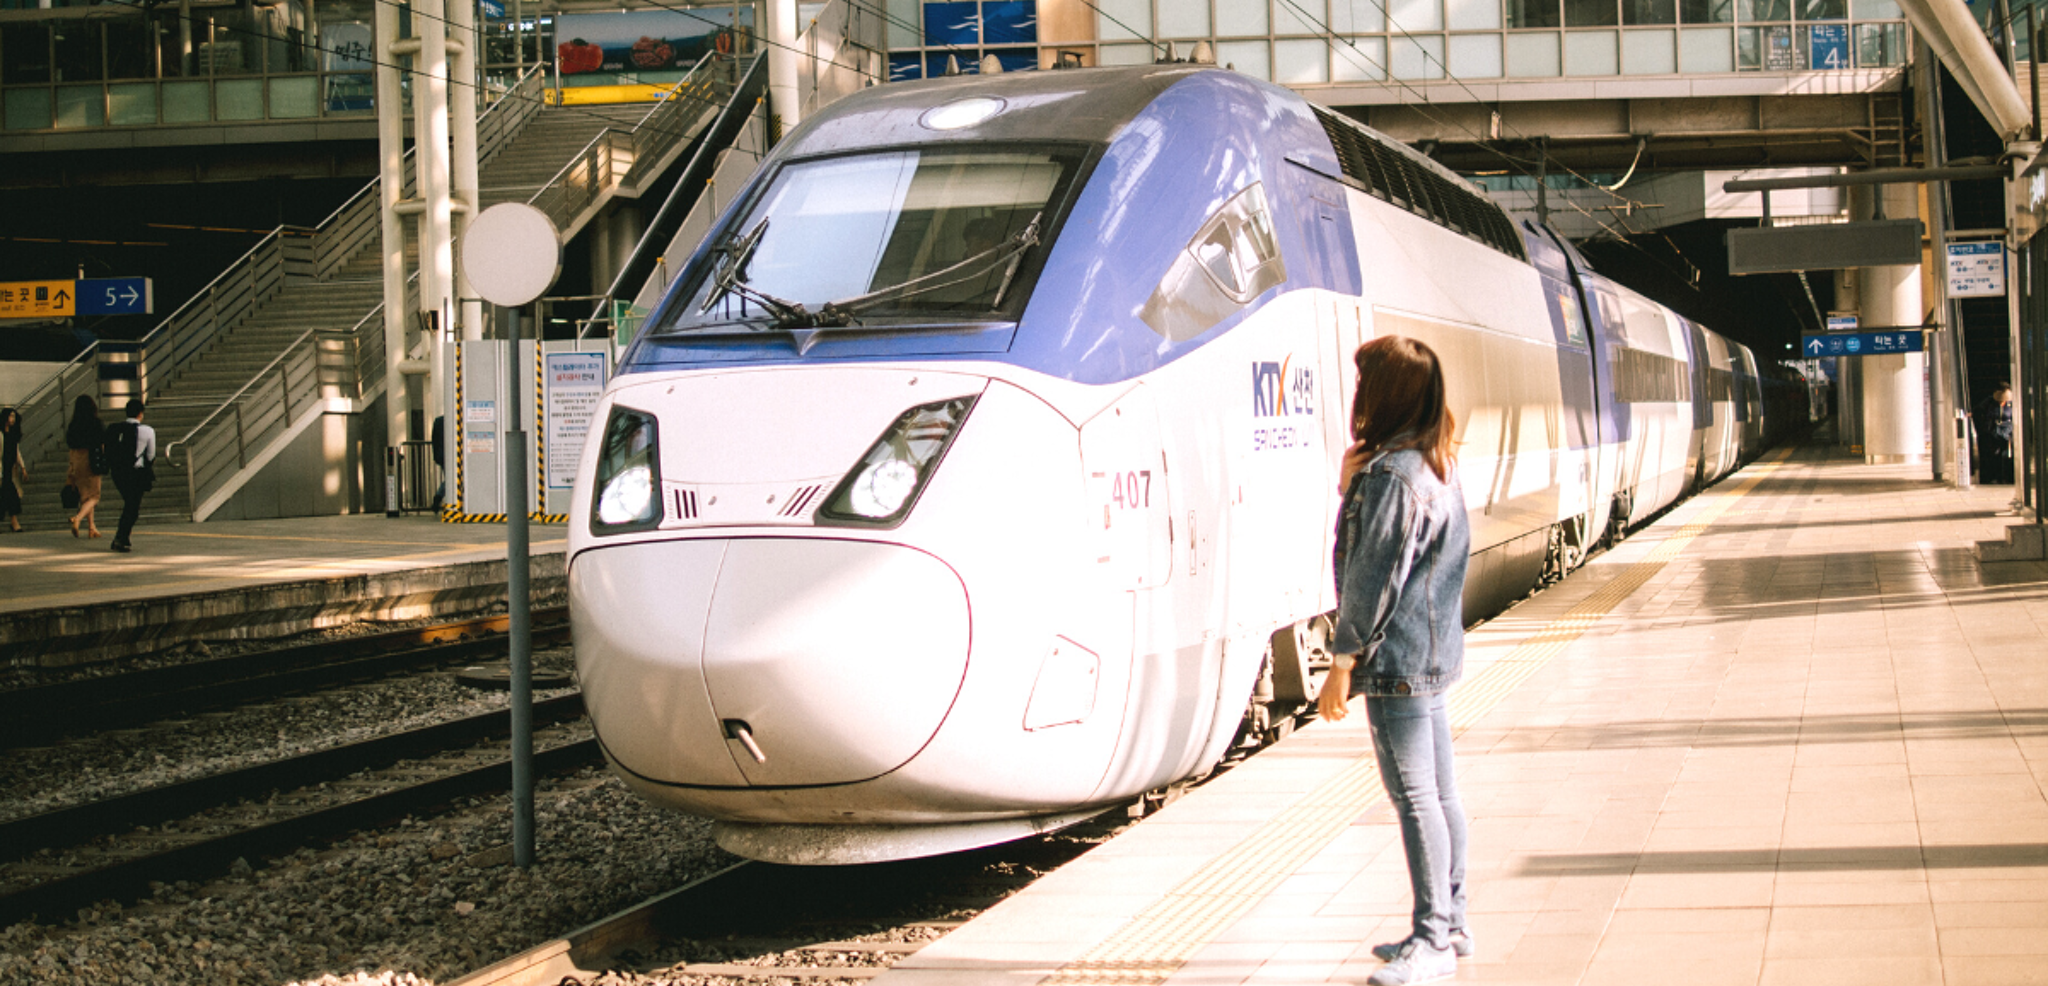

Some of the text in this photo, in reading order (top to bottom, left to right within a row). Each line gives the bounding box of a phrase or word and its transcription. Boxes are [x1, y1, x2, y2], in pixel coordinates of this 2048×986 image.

[1824, 47, 1841, 70] 4
[20, 287, 30, 302] 곳
[105, 287, 117, 307] 5
[1874, 335, 1892, 346] 타는
[1898, 333, 1907, 346] 곳
[1252, 352, 1314, 417] KTX 산천
[1112, 470, 1151, 510] 407
